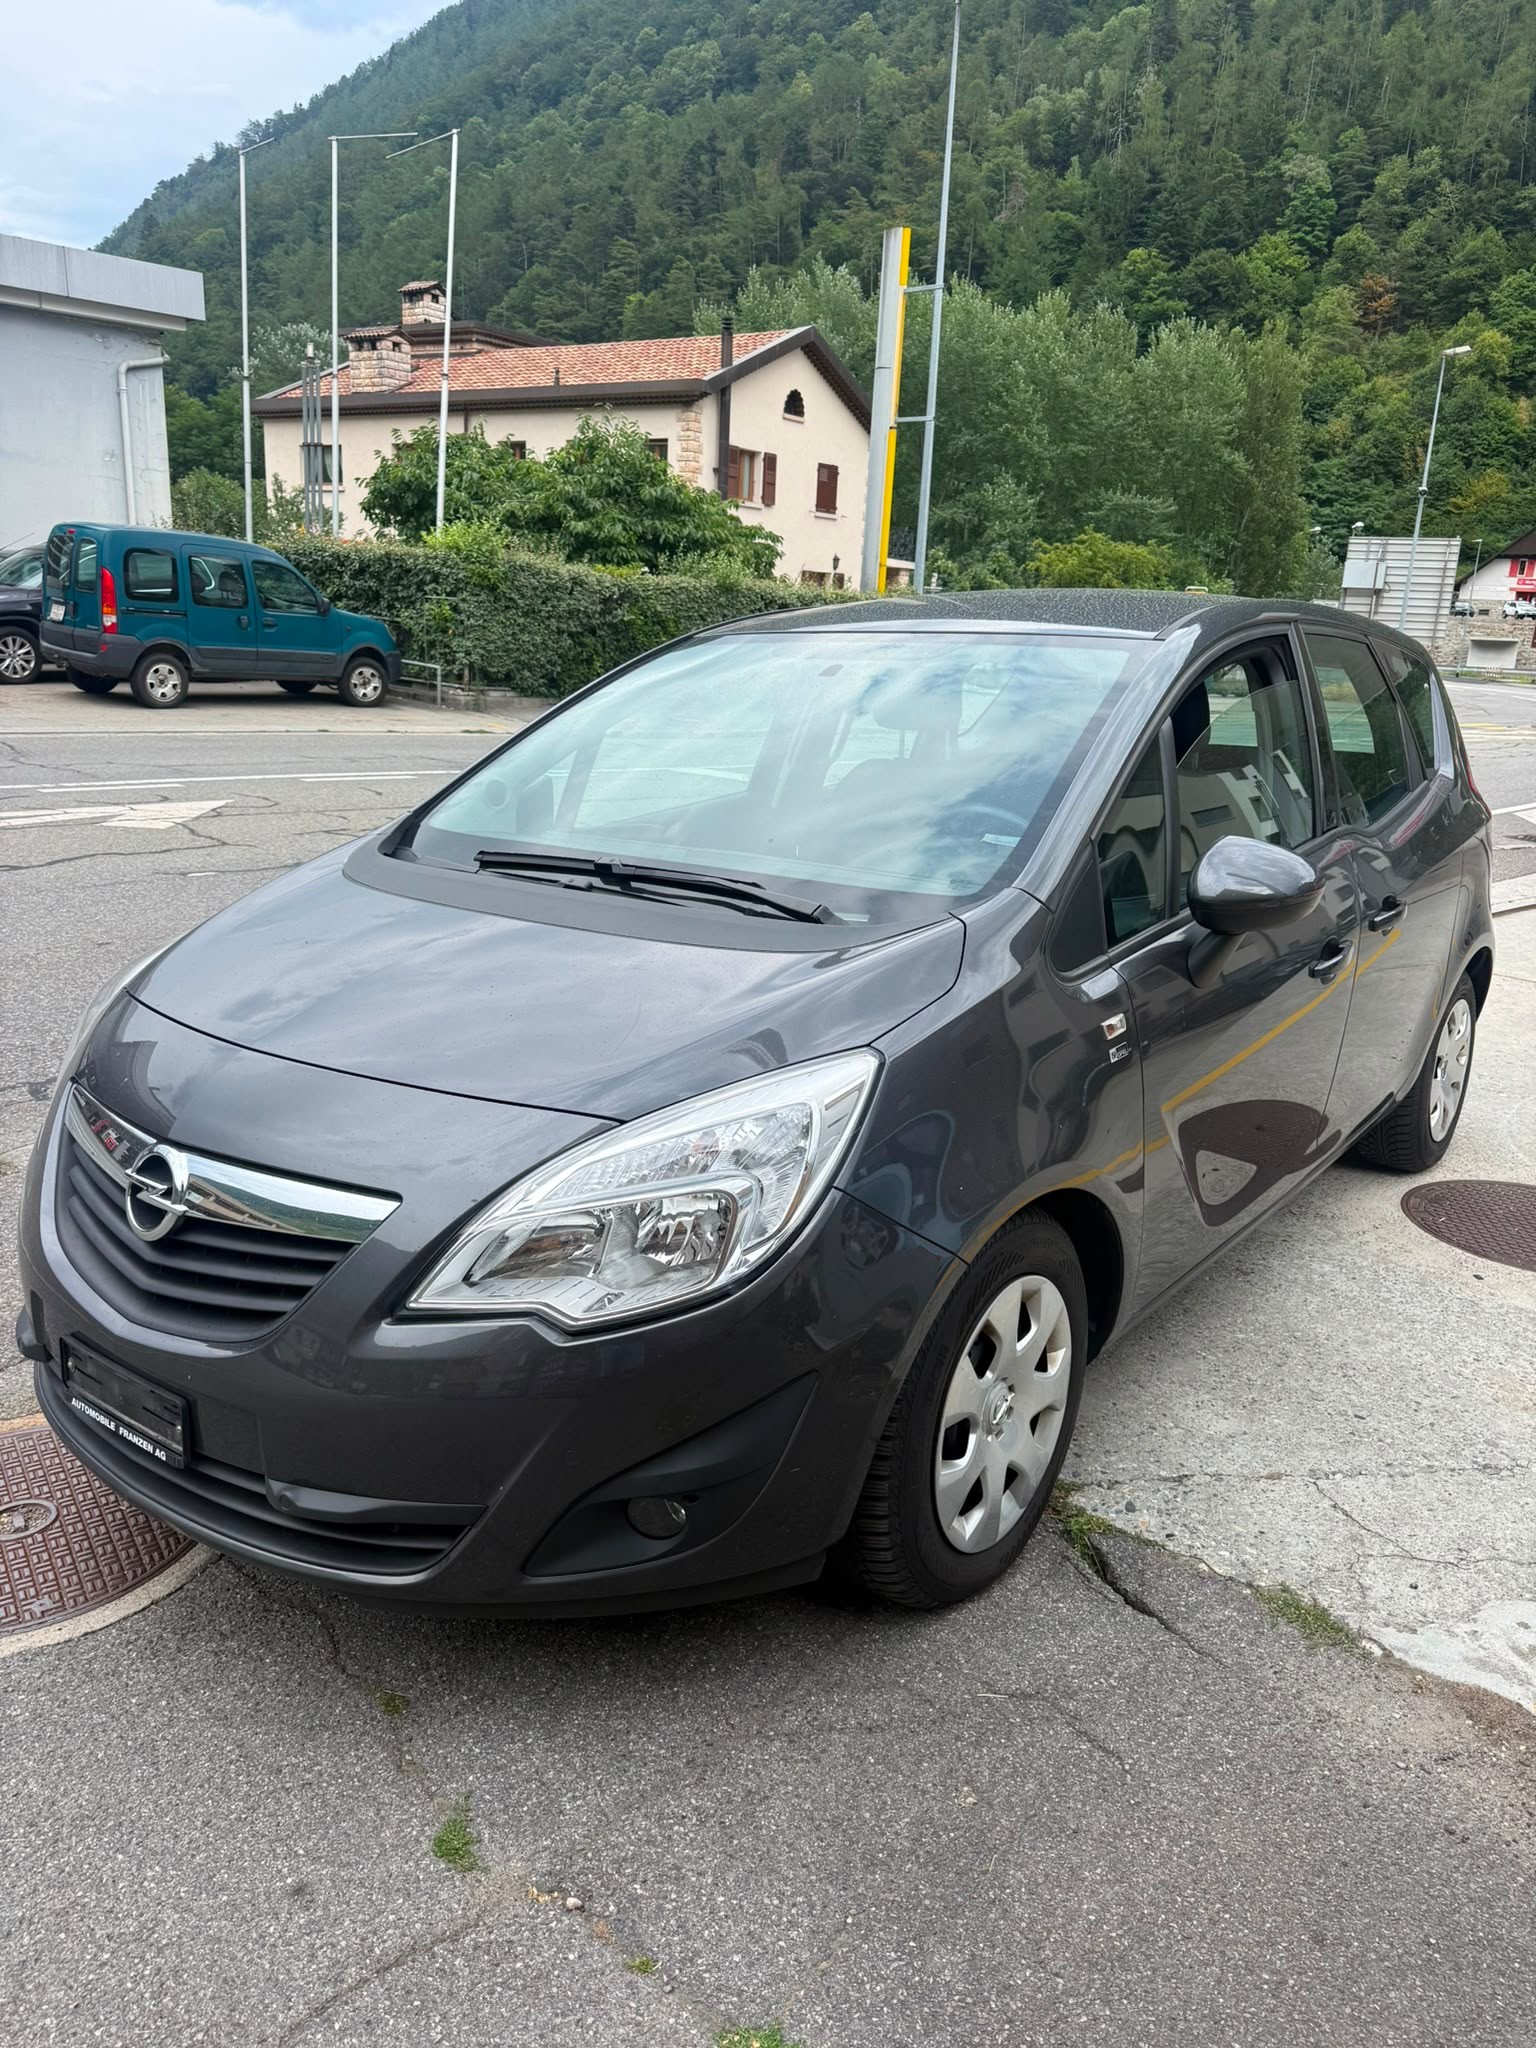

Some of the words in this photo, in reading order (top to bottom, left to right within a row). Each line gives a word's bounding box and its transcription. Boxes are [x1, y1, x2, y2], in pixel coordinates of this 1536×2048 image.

[71, 1397, 116, 1431] AUTOMOBILE
[119, 1426, 154, 1454] FRANZEN
[154, 1448, 167, 1461] AG
